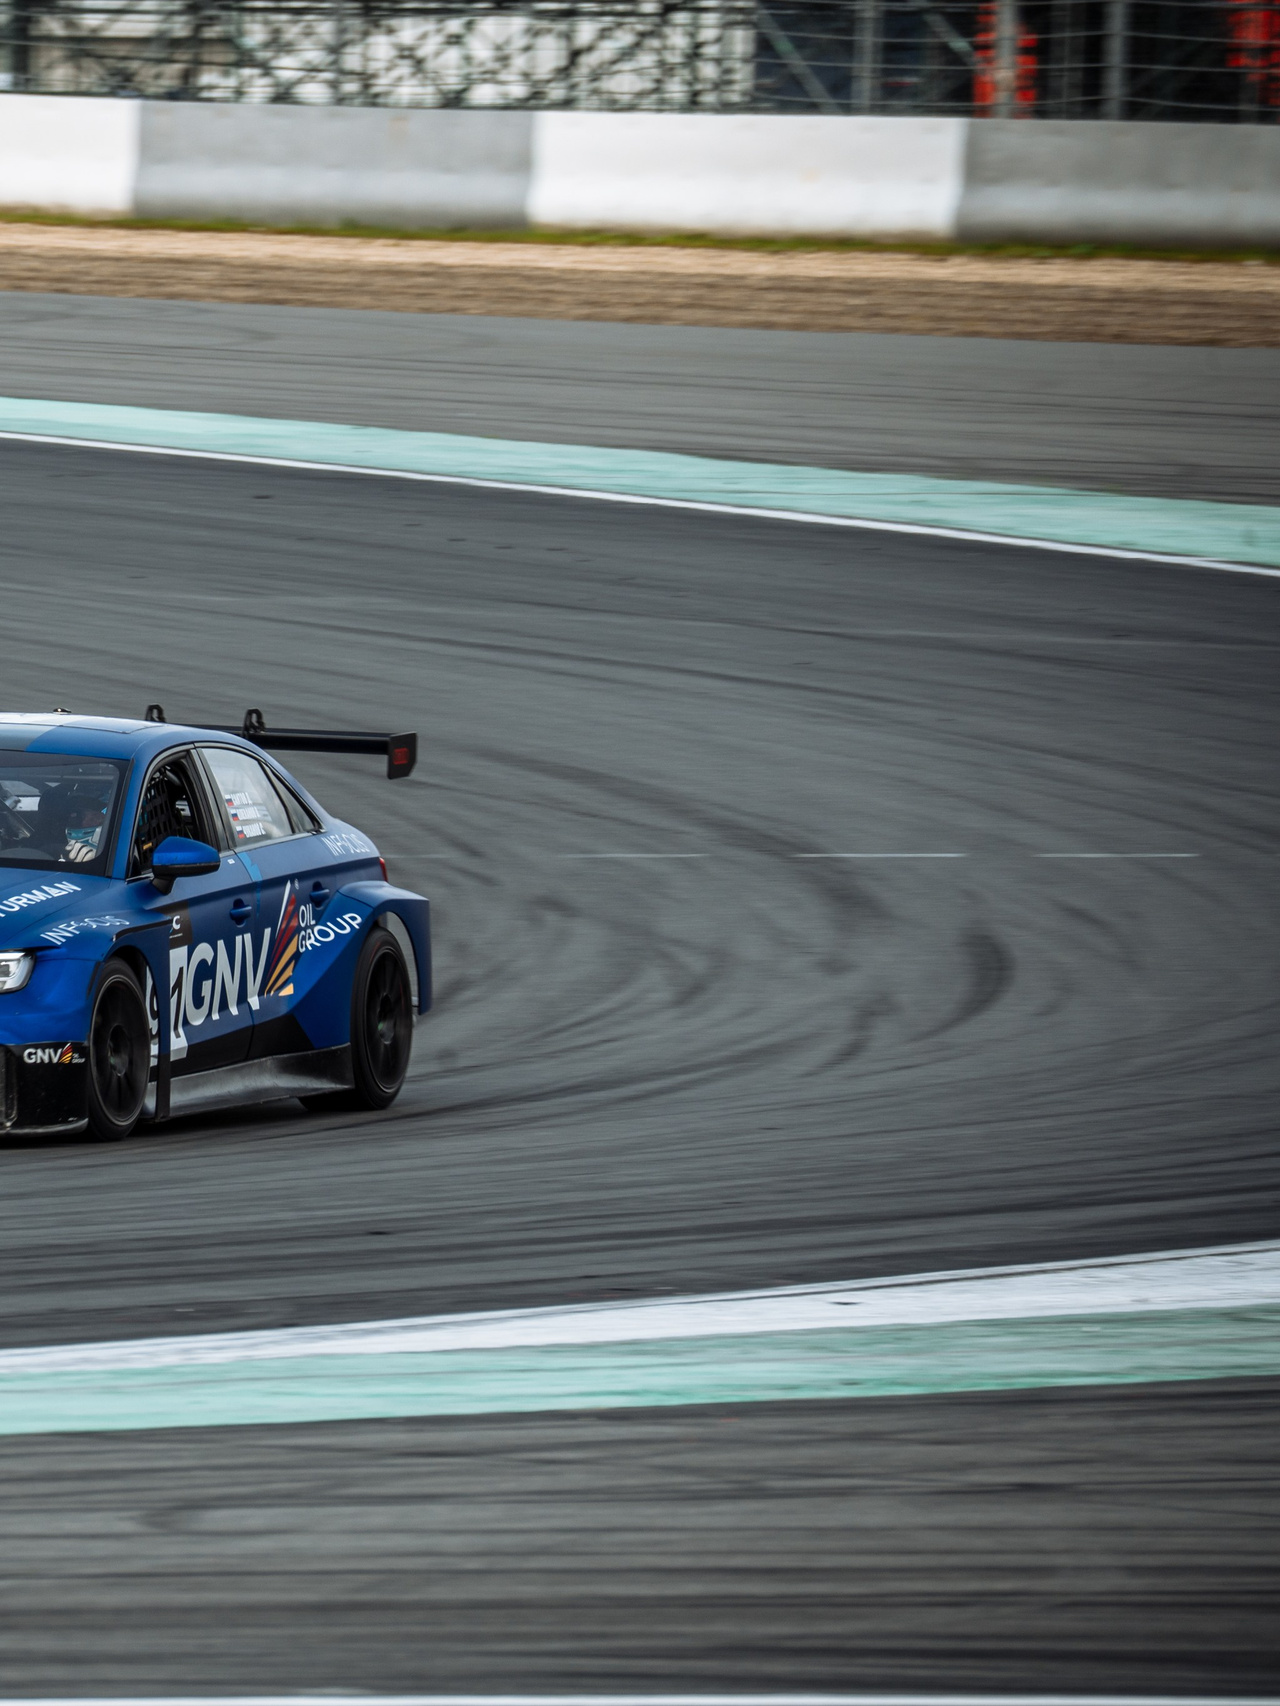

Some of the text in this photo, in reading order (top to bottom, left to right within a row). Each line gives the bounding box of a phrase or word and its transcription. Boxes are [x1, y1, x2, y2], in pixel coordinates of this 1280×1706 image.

[298, 903, 316, 927] OIL
[298, 913, 363, 953] GROUP
[185, 926, 272, 1027] GNV
[23, 1048, 63, 1064] GNV
